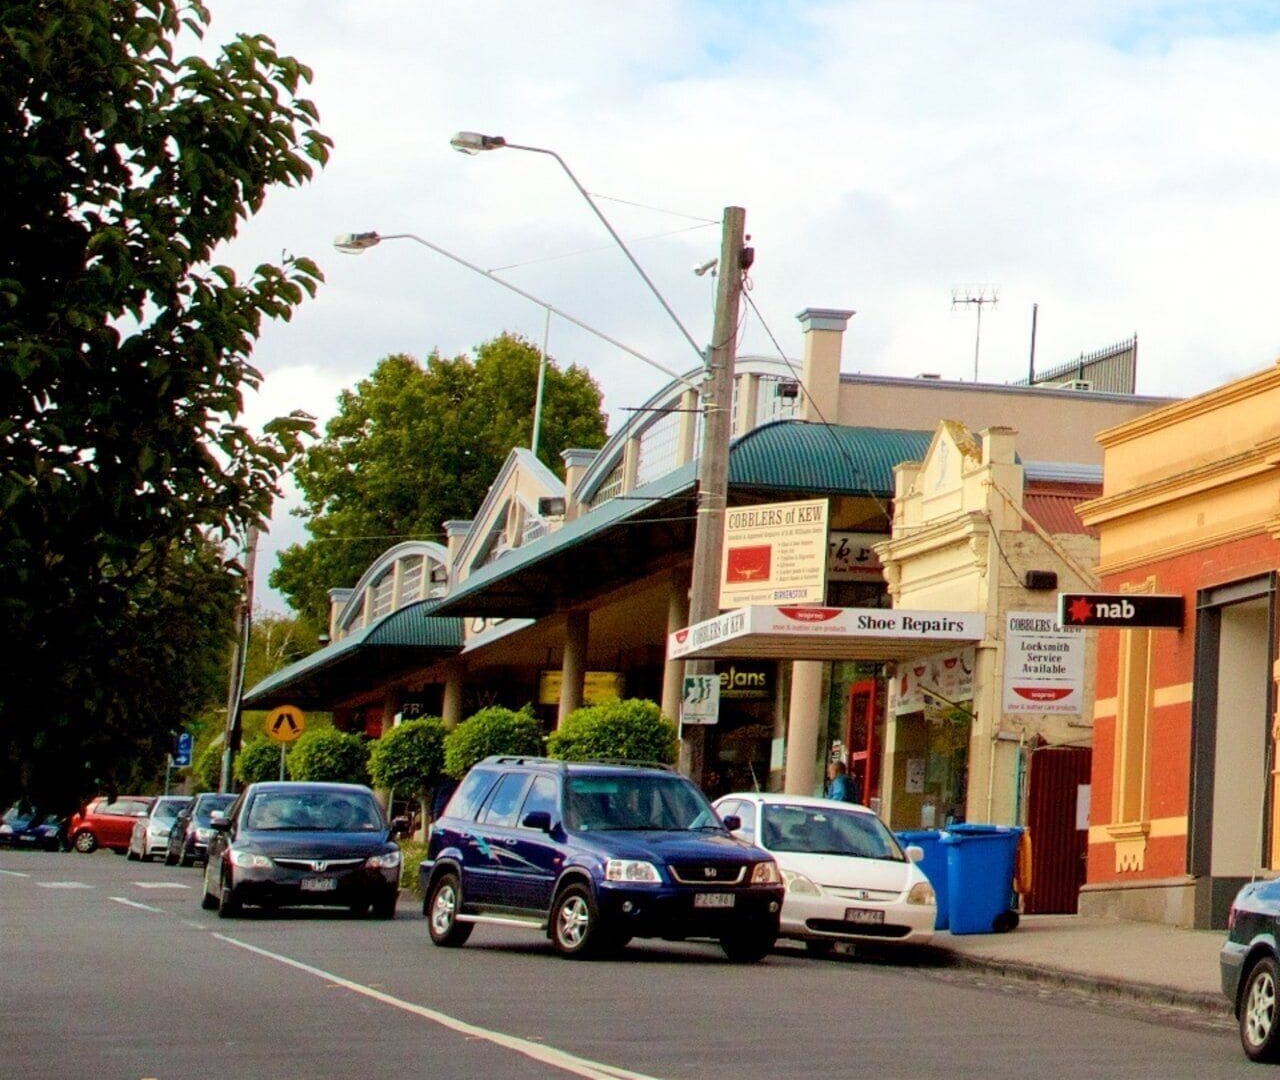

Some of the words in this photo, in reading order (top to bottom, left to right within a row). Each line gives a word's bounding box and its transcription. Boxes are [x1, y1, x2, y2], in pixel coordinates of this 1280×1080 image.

[729, 510, 782, 529] COBBLERS
[785, 508, 796, 524] of
[798, 505, 823, 523] KEW
[1096, 600, 1135, 618] nab
[858, 615, 896, 630] Shoe
[902, 617, 964, 633] Repairs
[1010, 618, 1051, 632] COBBLERS
[1021, 641, 1070, 652] Locksmith
[1027, 652, 1062, 663] Service
[1022, 663, 1066, 674] Available
